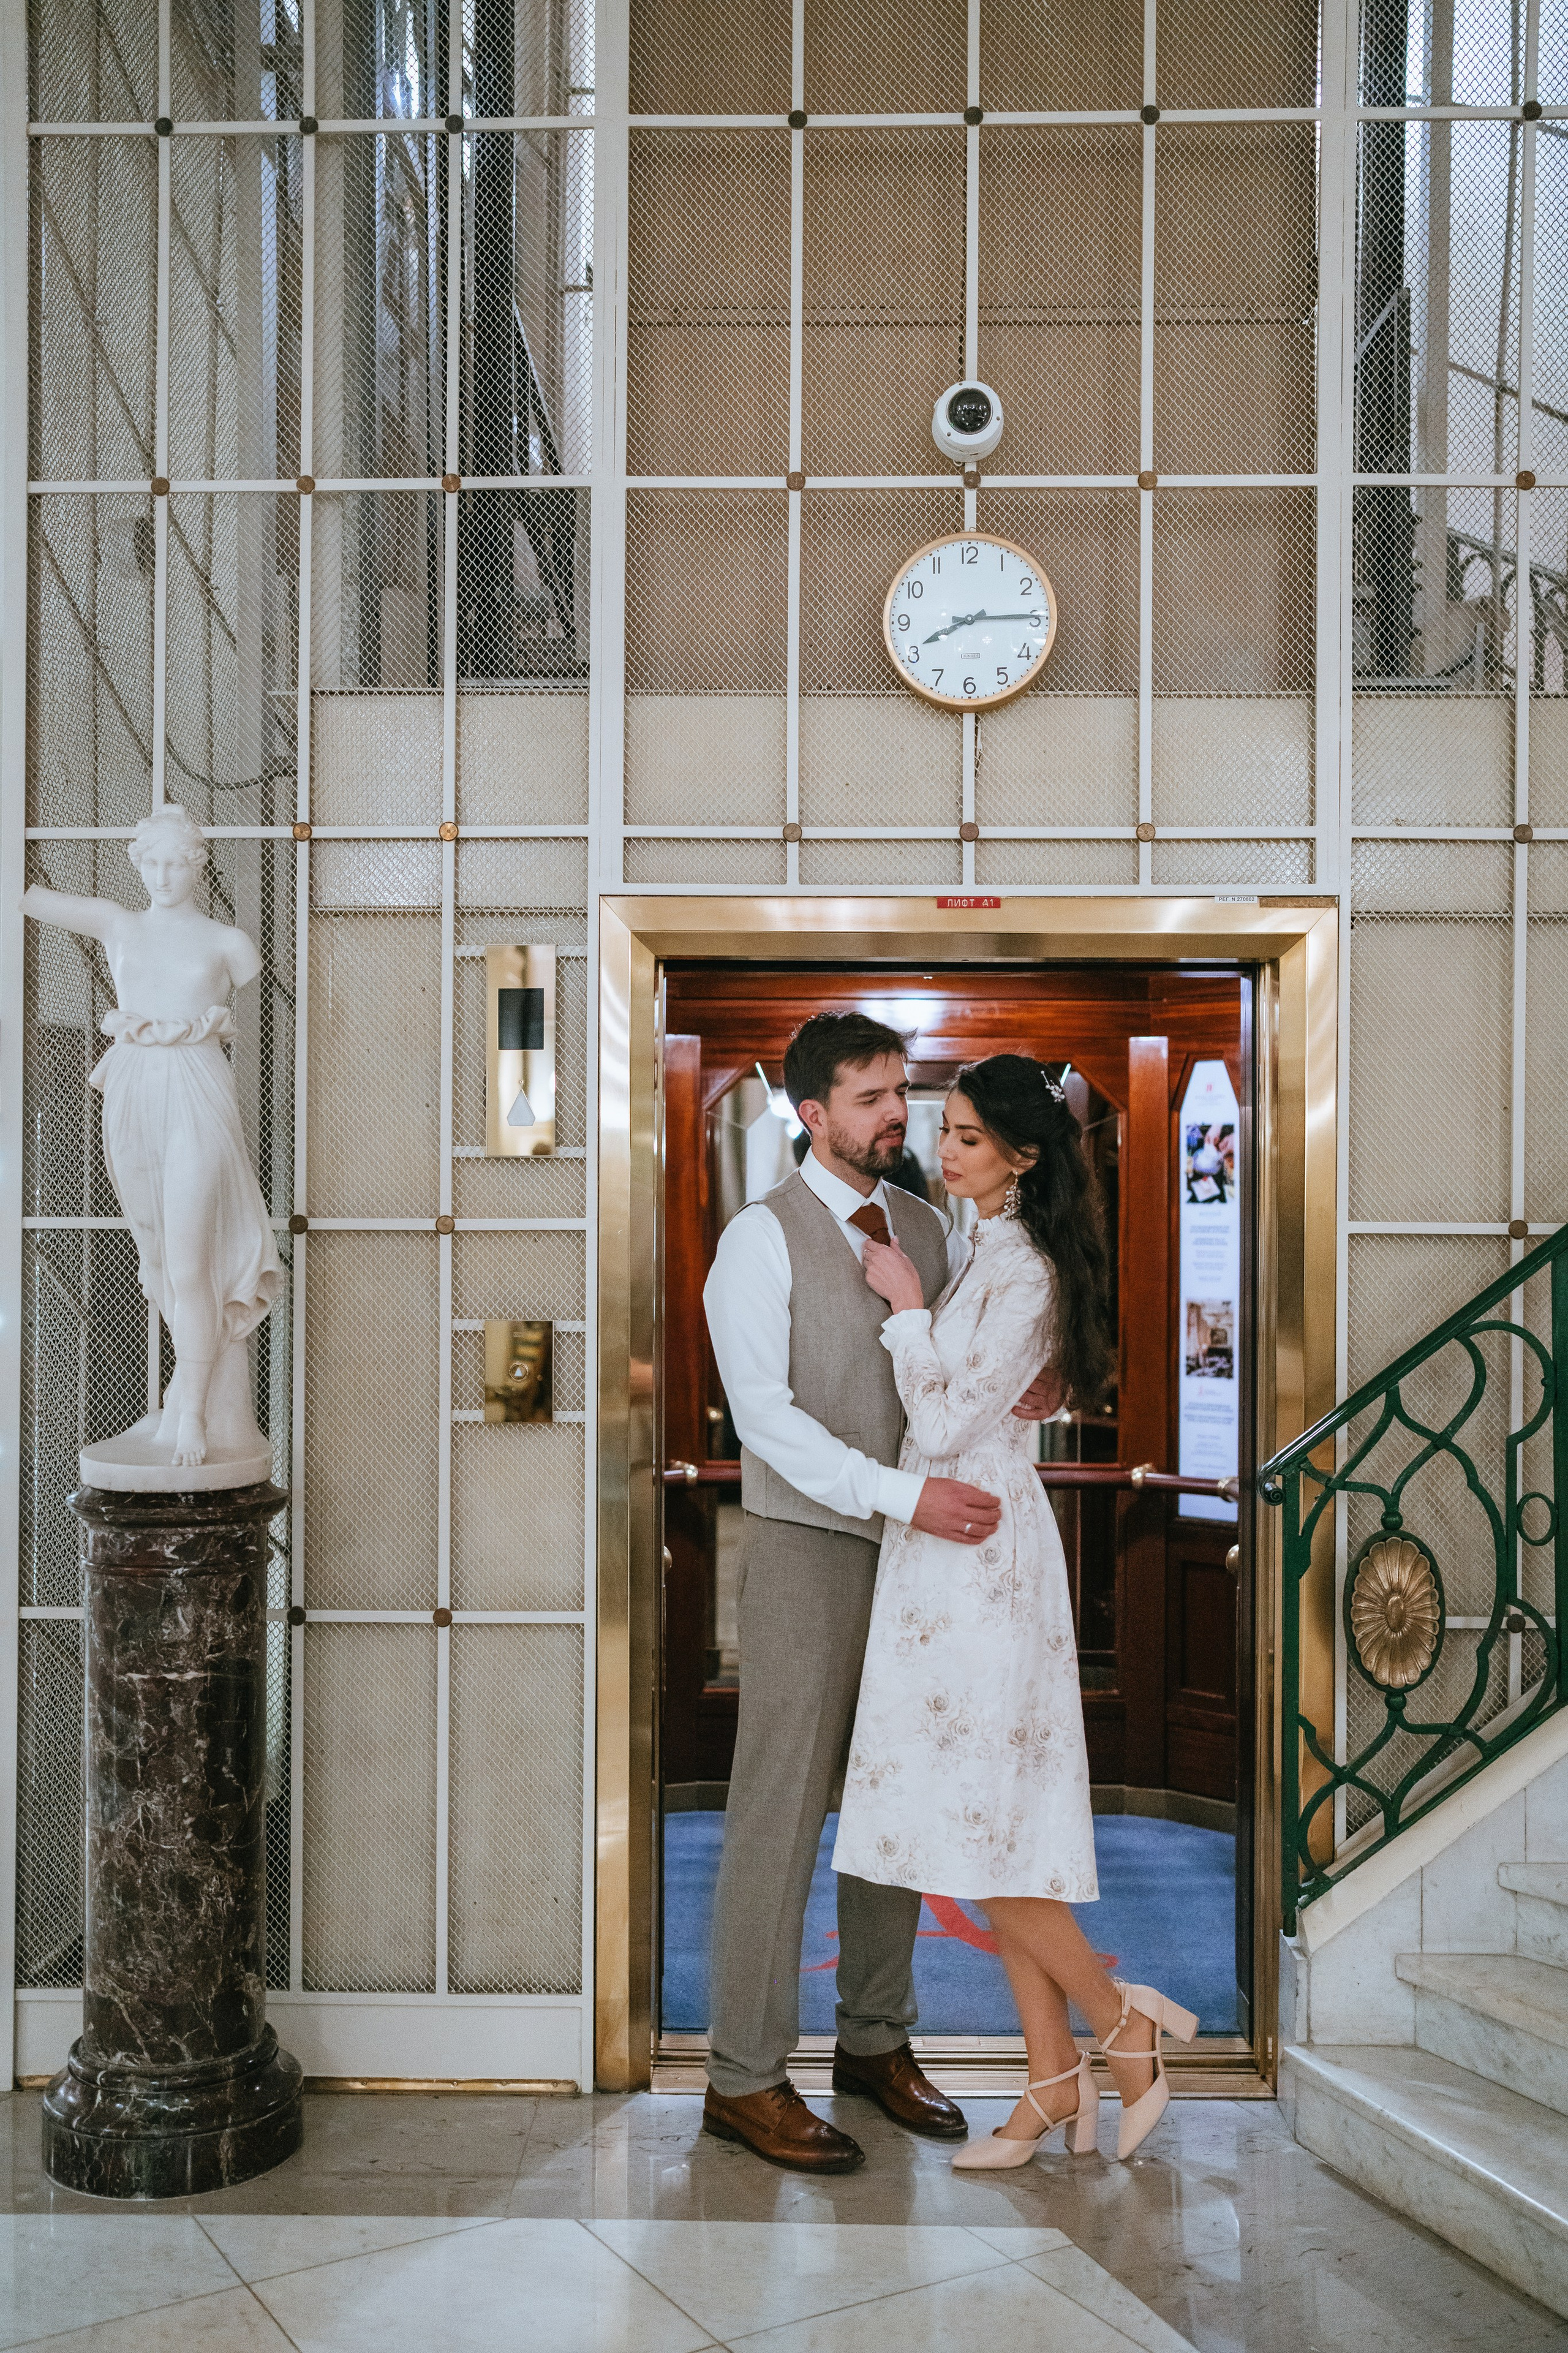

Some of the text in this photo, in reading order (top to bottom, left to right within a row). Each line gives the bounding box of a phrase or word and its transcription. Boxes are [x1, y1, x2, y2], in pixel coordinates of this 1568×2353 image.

[961, 546, 979, 565] 12
[1000, 554, 1004, 572] 1
[933, 556, 941, 574] 11
[907, 580, 924, 599] 10
[1020, 577, 1033, 595] 2
[897, 614, 911, 632] 9
[1029, 610, 1041, 627] 3
[908, 645, 920, 663] 8
[1017, 643, 1032, 660] 4
[932, 668, 944, 687] 7
[997, 667, 1009, 685] 5
[963, 676, 976, 695] 6
[947, 899, 974, 907] ЛИФТ
